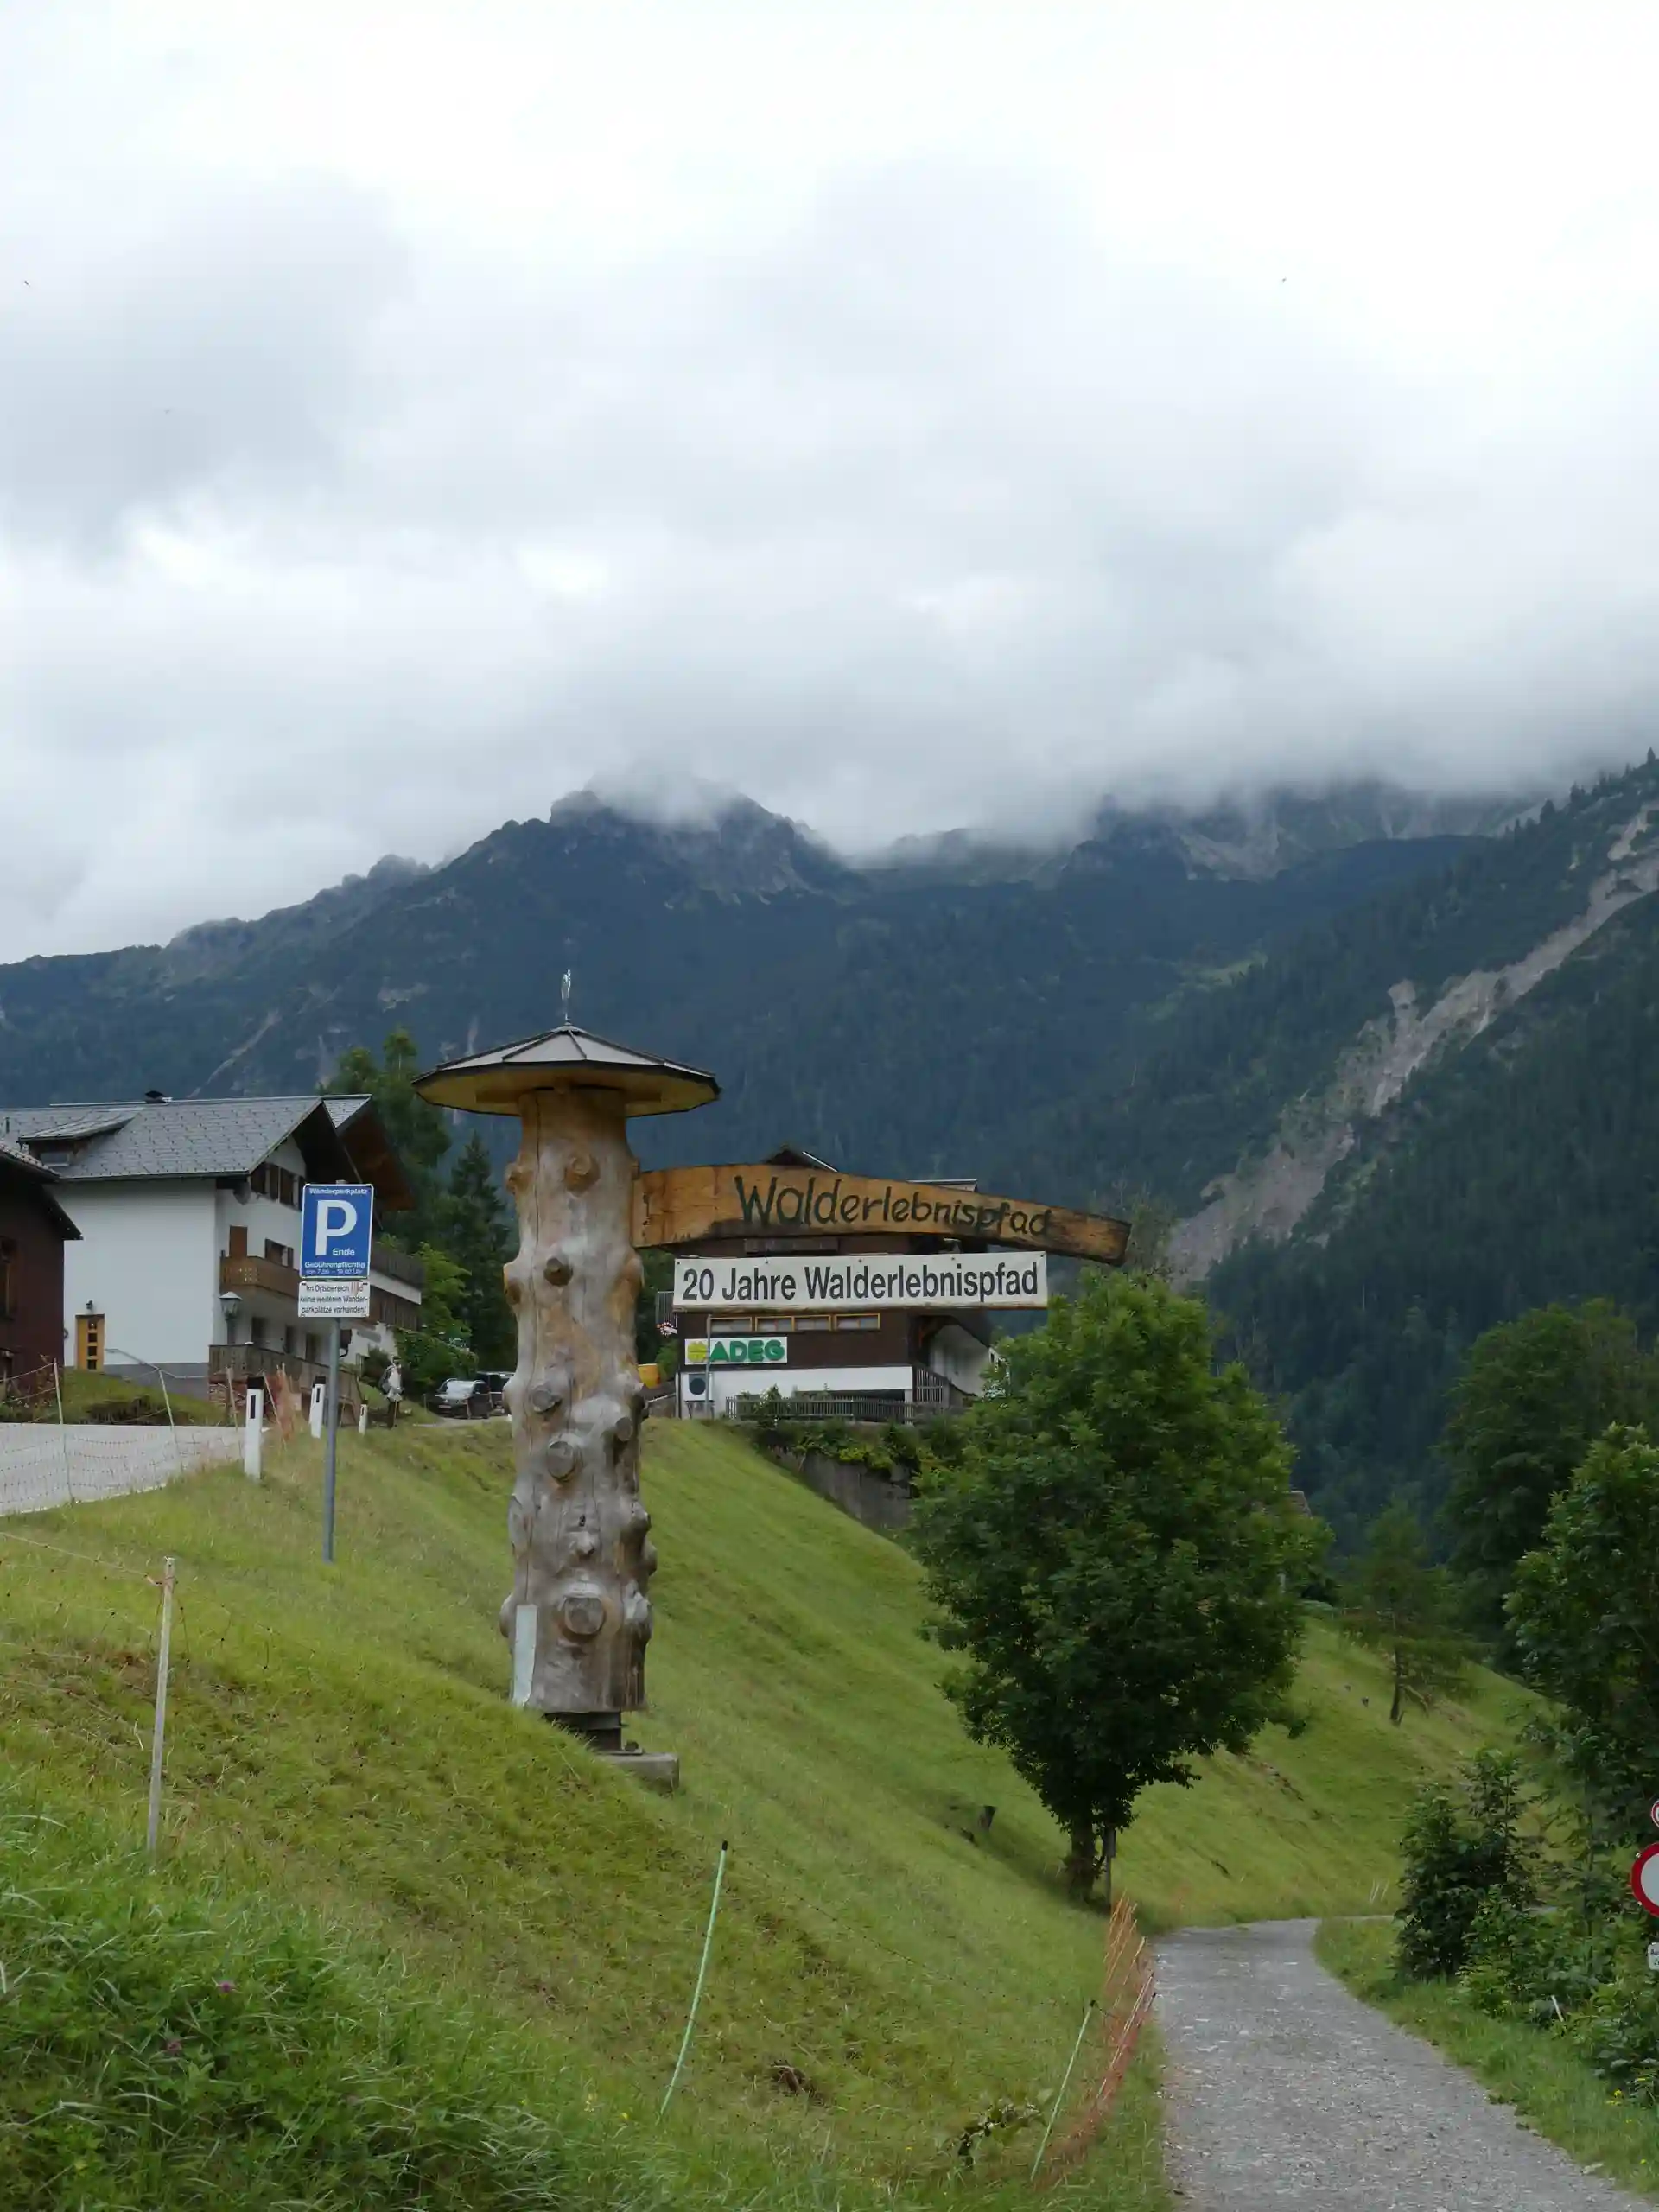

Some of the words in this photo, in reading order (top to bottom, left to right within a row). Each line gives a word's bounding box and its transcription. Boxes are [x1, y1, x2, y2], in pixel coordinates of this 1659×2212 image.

[308, 1187, 368, 1196] Wanderparkplatz
[734, 1175, 1052, 1237] Walderlebnispfad
[315, 1199, 358, 1256] P
[332, 1248, 355, 1256] Ende
[304, 1261, 365, 1269] Gebührenpflichtig
[315, 1284, 349, 1293] Ortsbereich
[683, 1270, 715, 1300] 20
[721, 1267, 796, 1300] Jahre
[804, 1262, 1039, 1303] Walderlebnispfad
[709, 1339, 785, 1363] ADEG
